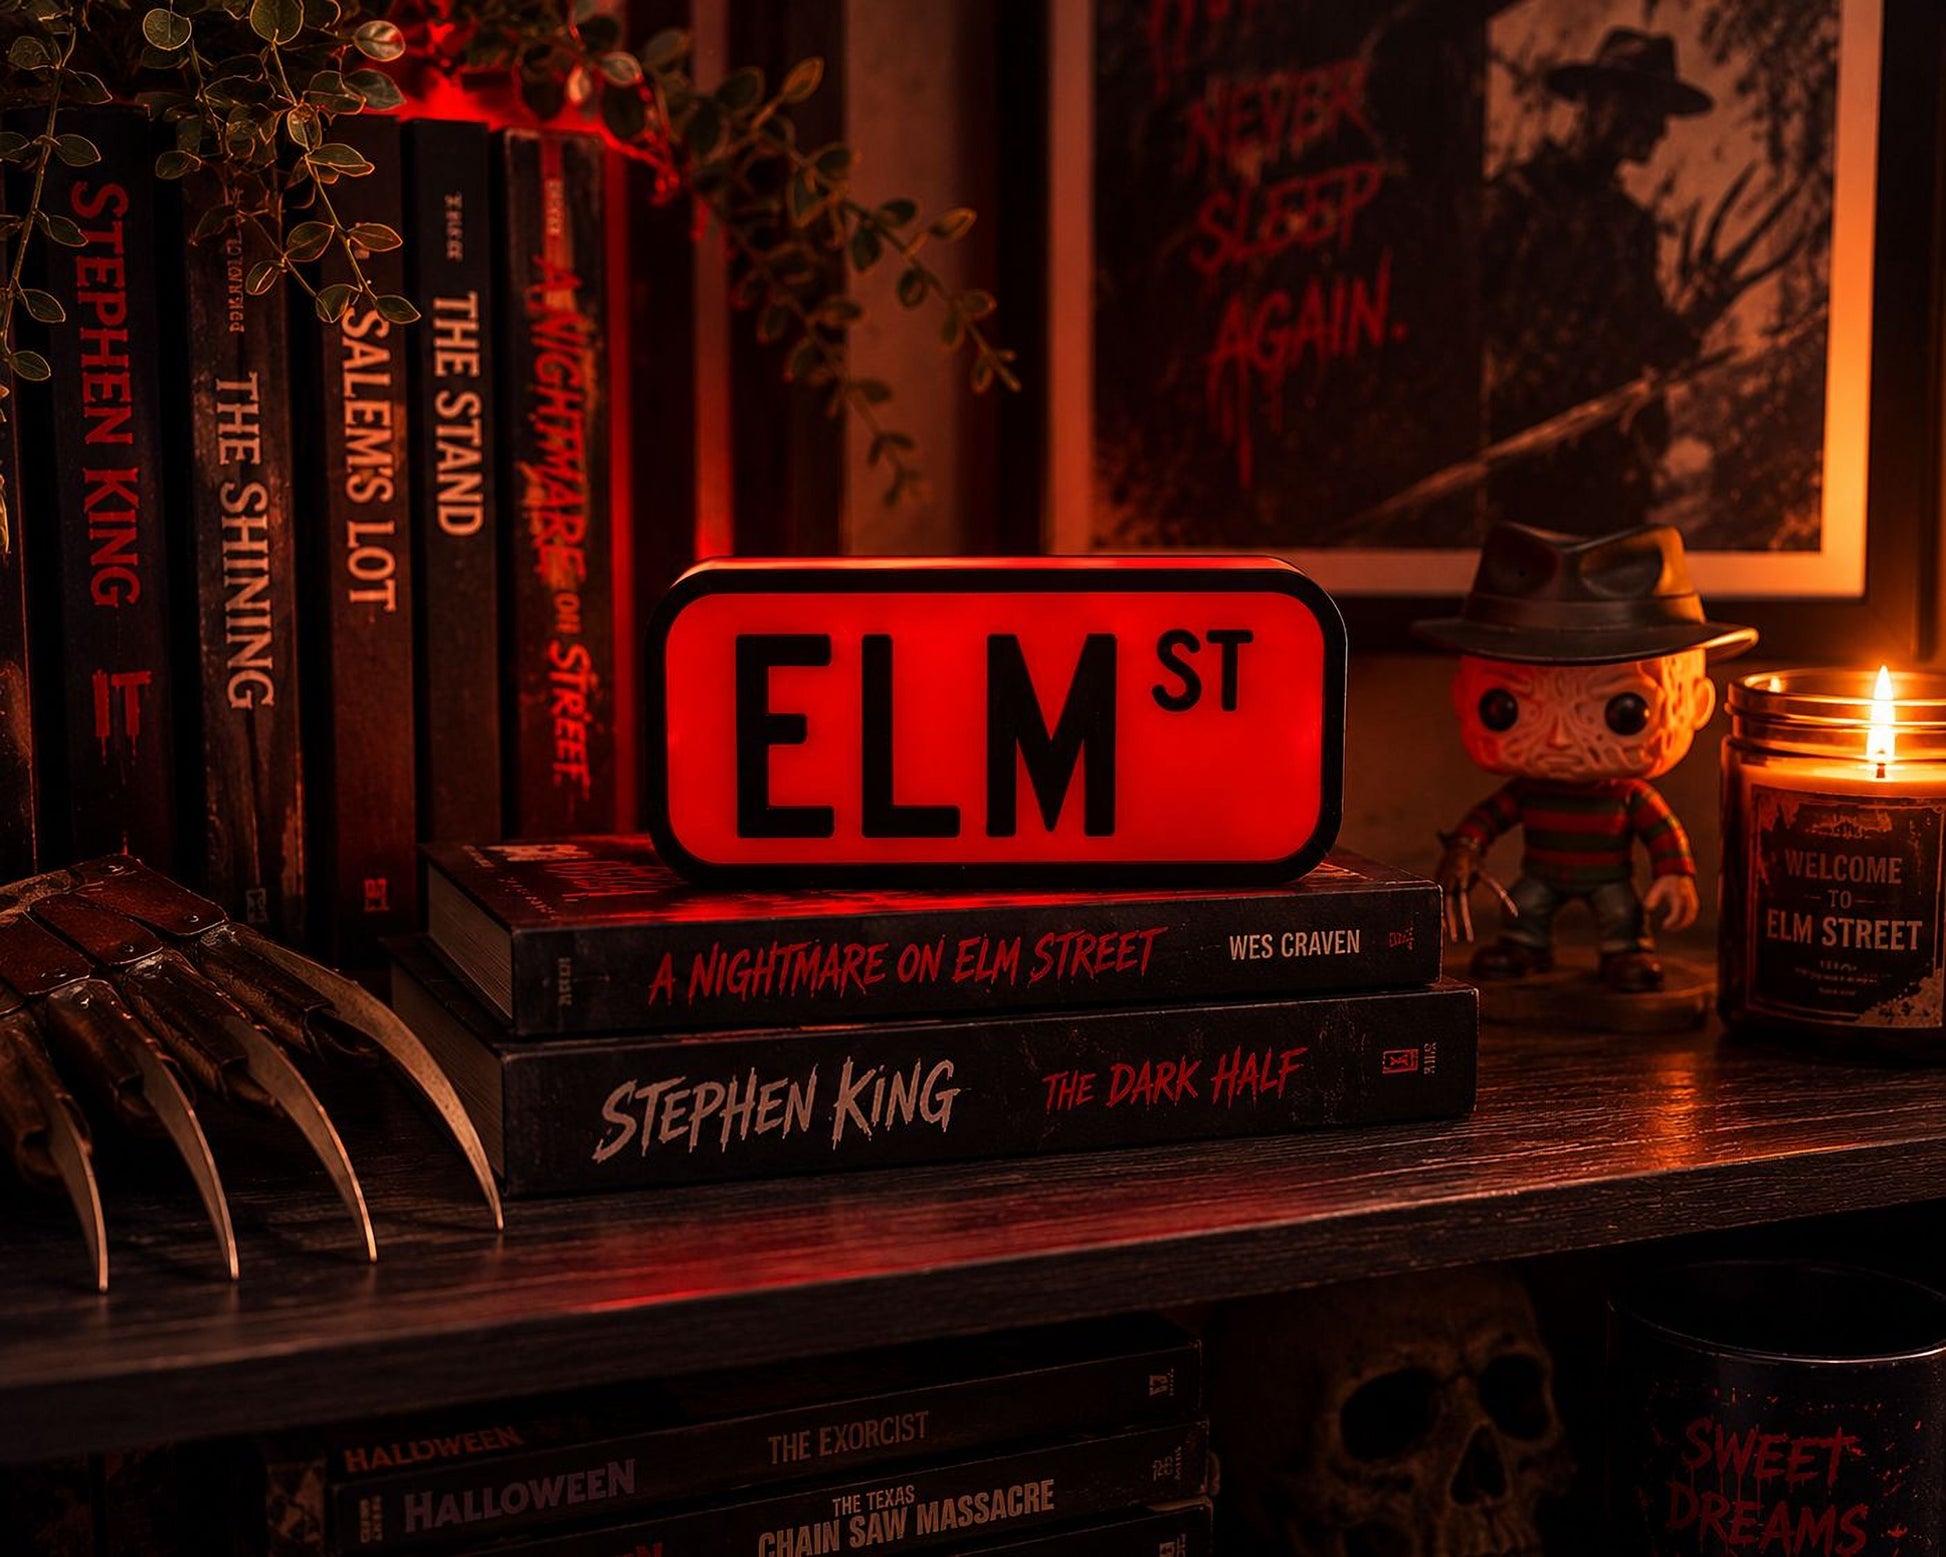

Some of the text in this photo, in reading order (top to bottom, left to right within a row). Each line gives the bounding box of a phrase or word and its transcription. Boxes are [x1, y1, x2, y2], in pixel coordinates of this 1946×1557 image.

[1190, 162, 1386, 272] SLEEP
[432, 289, 481, 379] THE
[1204, 246, 1408, 410] AGAIN.
[69, 179, 142, 608] STEPHEN KING
[215, 370, 262, 466] THE
[433, 389, 485, 537] STAND
[527, 303, 588, 582] NIGHTMARE
[219, 480, 276, 711] SHINING
[346, 520, 398, 614] LOT
[90, 665, 153, 756] IT
[548, 640, 597, 800] STREET
[735, 629, 1254, 839] ELM ST
[1784, 849, 1904, 885] WELCOME
[1827, 888, 1853, 910] TO
[648, 925, 1168, 1006] A NIGHTMARE ON ELM STREET
[1229, 932, 1274, 961] WES
[1280, 929, 1361, 958] CRAVEN
[1766, 908, 1923, 951] ELM STREET
[592, 1062, 819, 1164] STEPHEN
[1041, 1044, 1309, 1114] THE DARK HALF
[767, 1409, 930, 1465] THE EXORCIST
[1680, 1413, 1863, 1494] SWEET
[404, 1456, 638, 1533] HALLOWEEN
[757, 1478, 1056, 1557] CHAIN SAW MASSACRE
[832, 1483, 916, 1519] THE TEXAS
[1665, 1479, 1870, 1557] DREAMS
